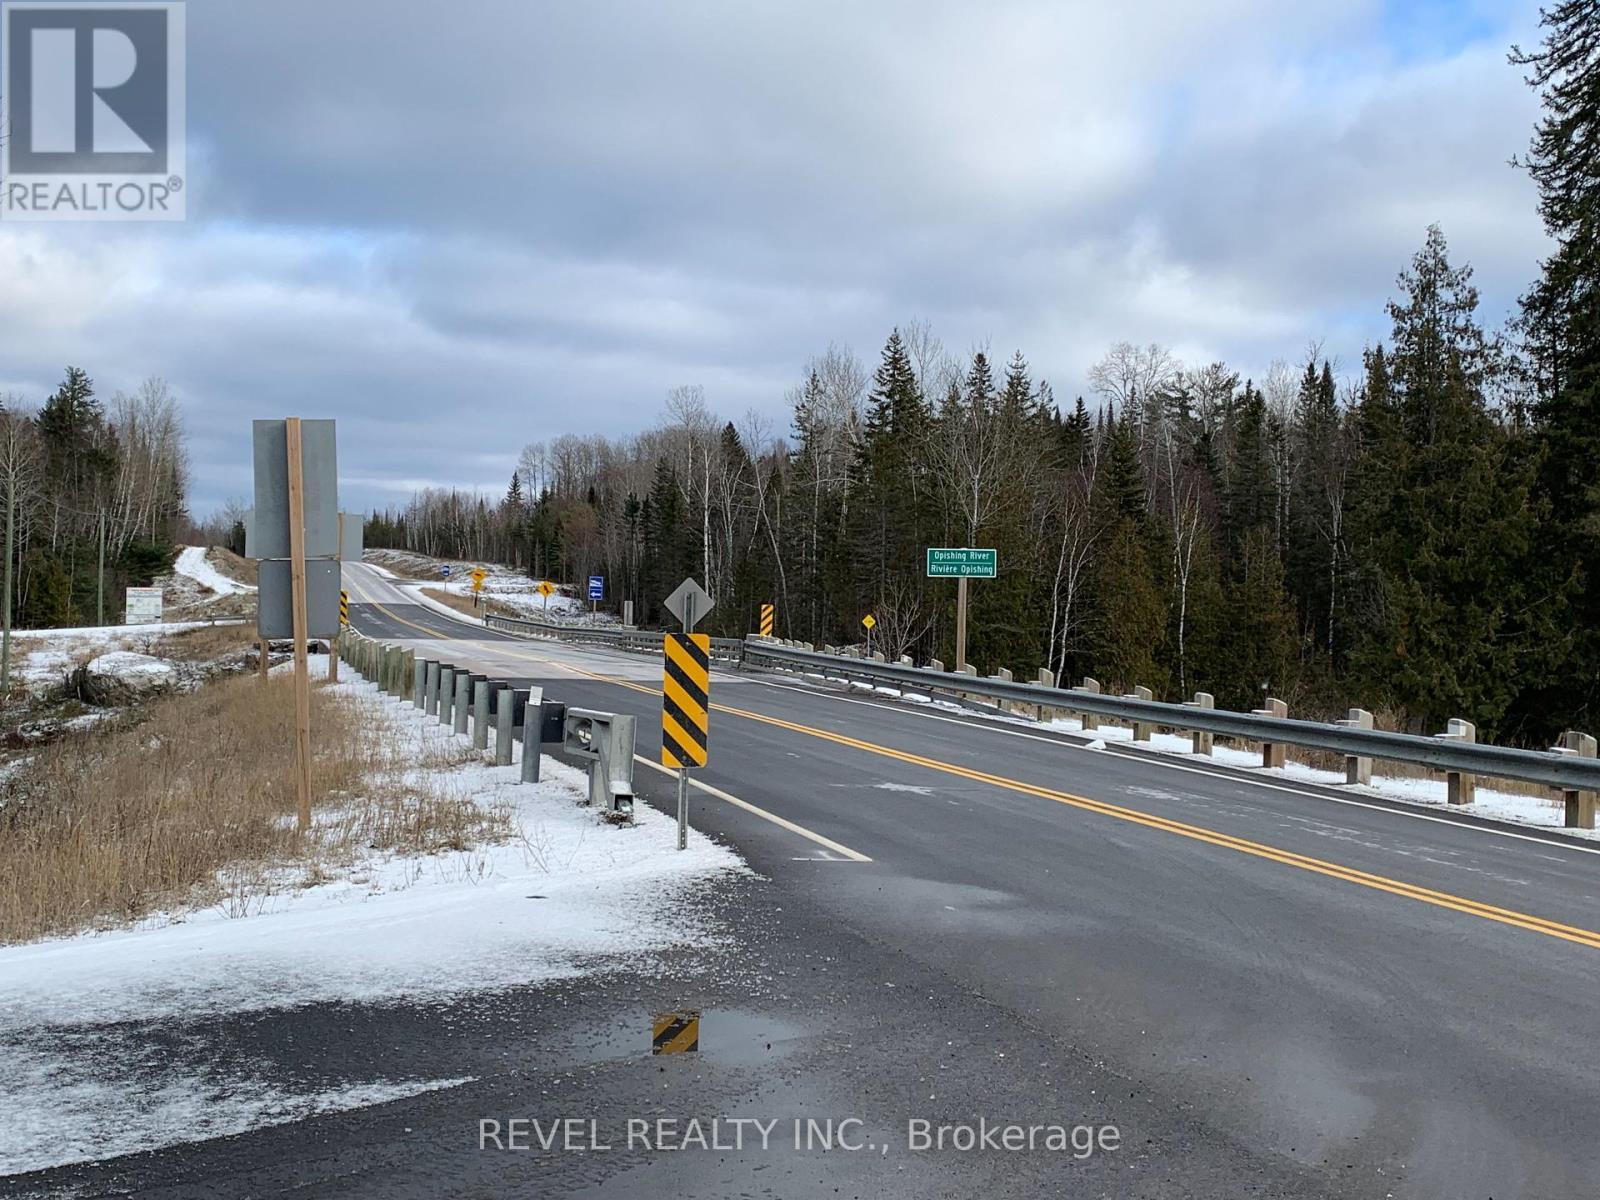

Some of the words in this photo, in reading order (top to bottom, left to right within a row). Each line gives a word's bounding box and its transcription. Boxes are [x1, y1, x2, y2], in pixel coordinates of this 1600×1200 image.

[934, 551, 967, 561] Opishing
[970, 551, 990, 560] River
[931, 564, 958, 573] Rivière
[961, 565, 993, 575] Opishing
